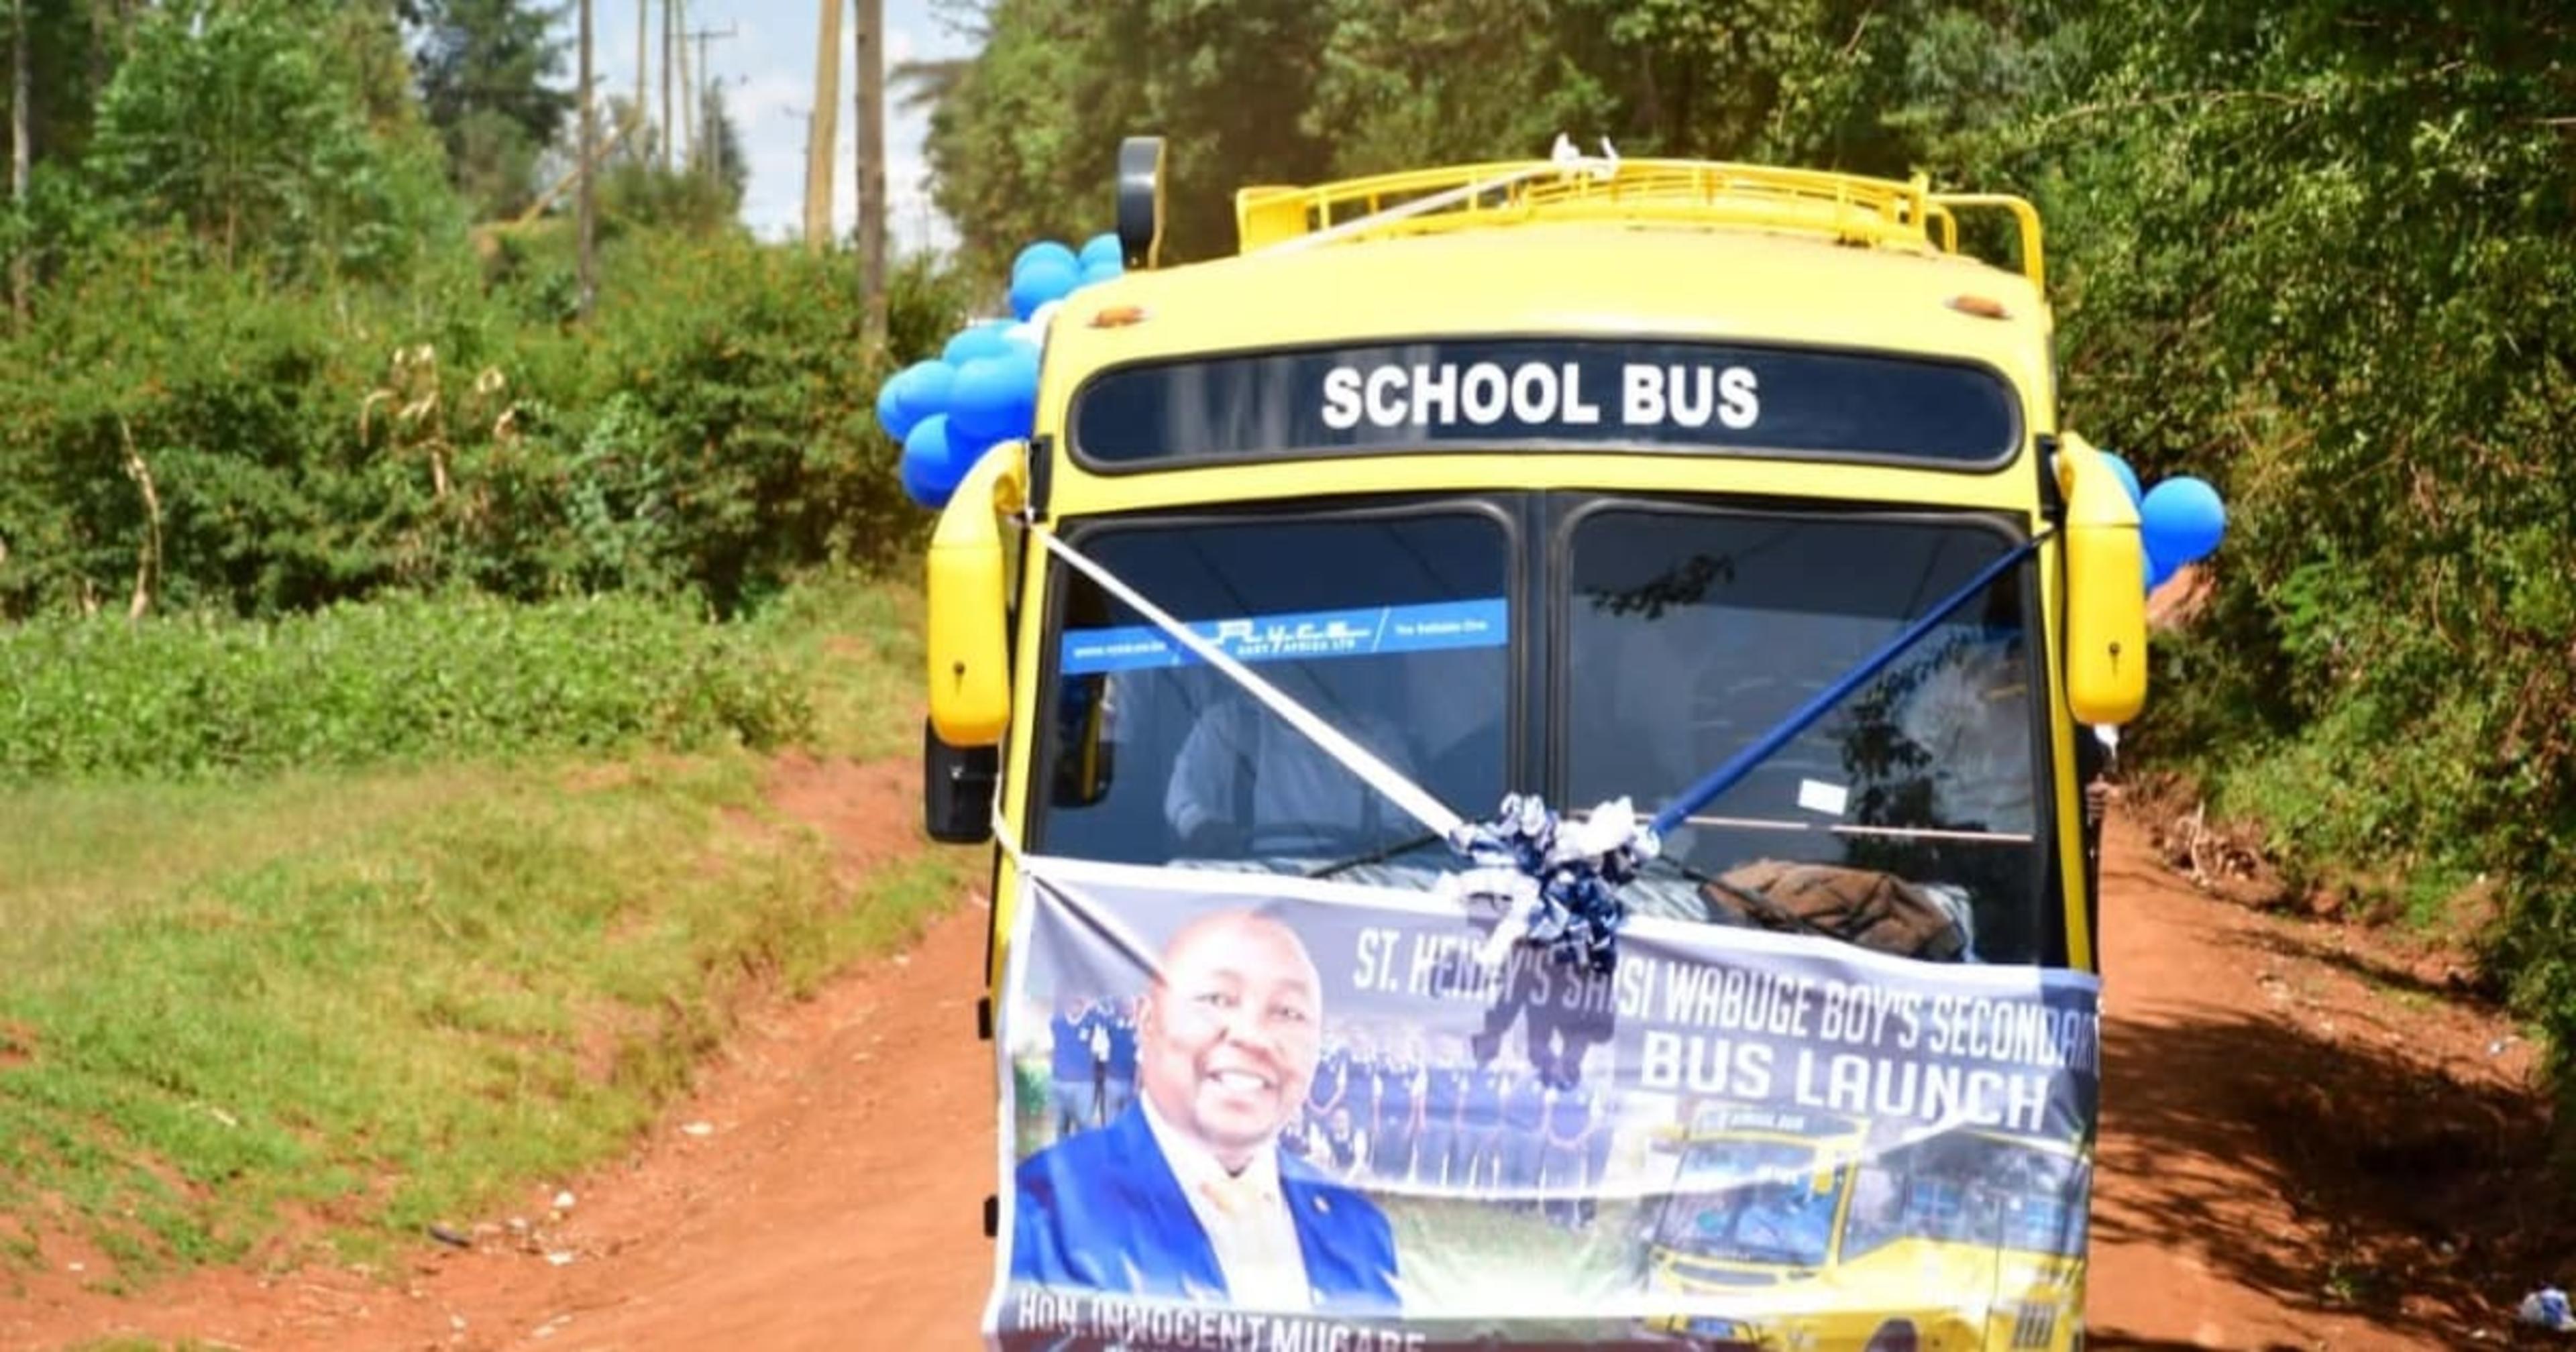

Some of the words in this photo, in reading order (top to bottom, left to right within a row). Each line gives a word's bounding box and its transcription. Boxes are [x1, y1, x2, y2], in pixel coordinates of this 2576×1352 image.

[1322, 362, 1600, 430] SCHOOL
[1622, 363, 1760, 430] BUS
[1352, 926, 1400, 993] ST.
[1666, 960, 1816, 1037] WABUGE
[1819, 979, 1923, 1050] BOY'S
[1642, 1029, 1775, 1100] BUS
[1794, 1048, 2049, 1133] LAUNCH
[1090, 1296, 1268, 1352] INNOCENT
